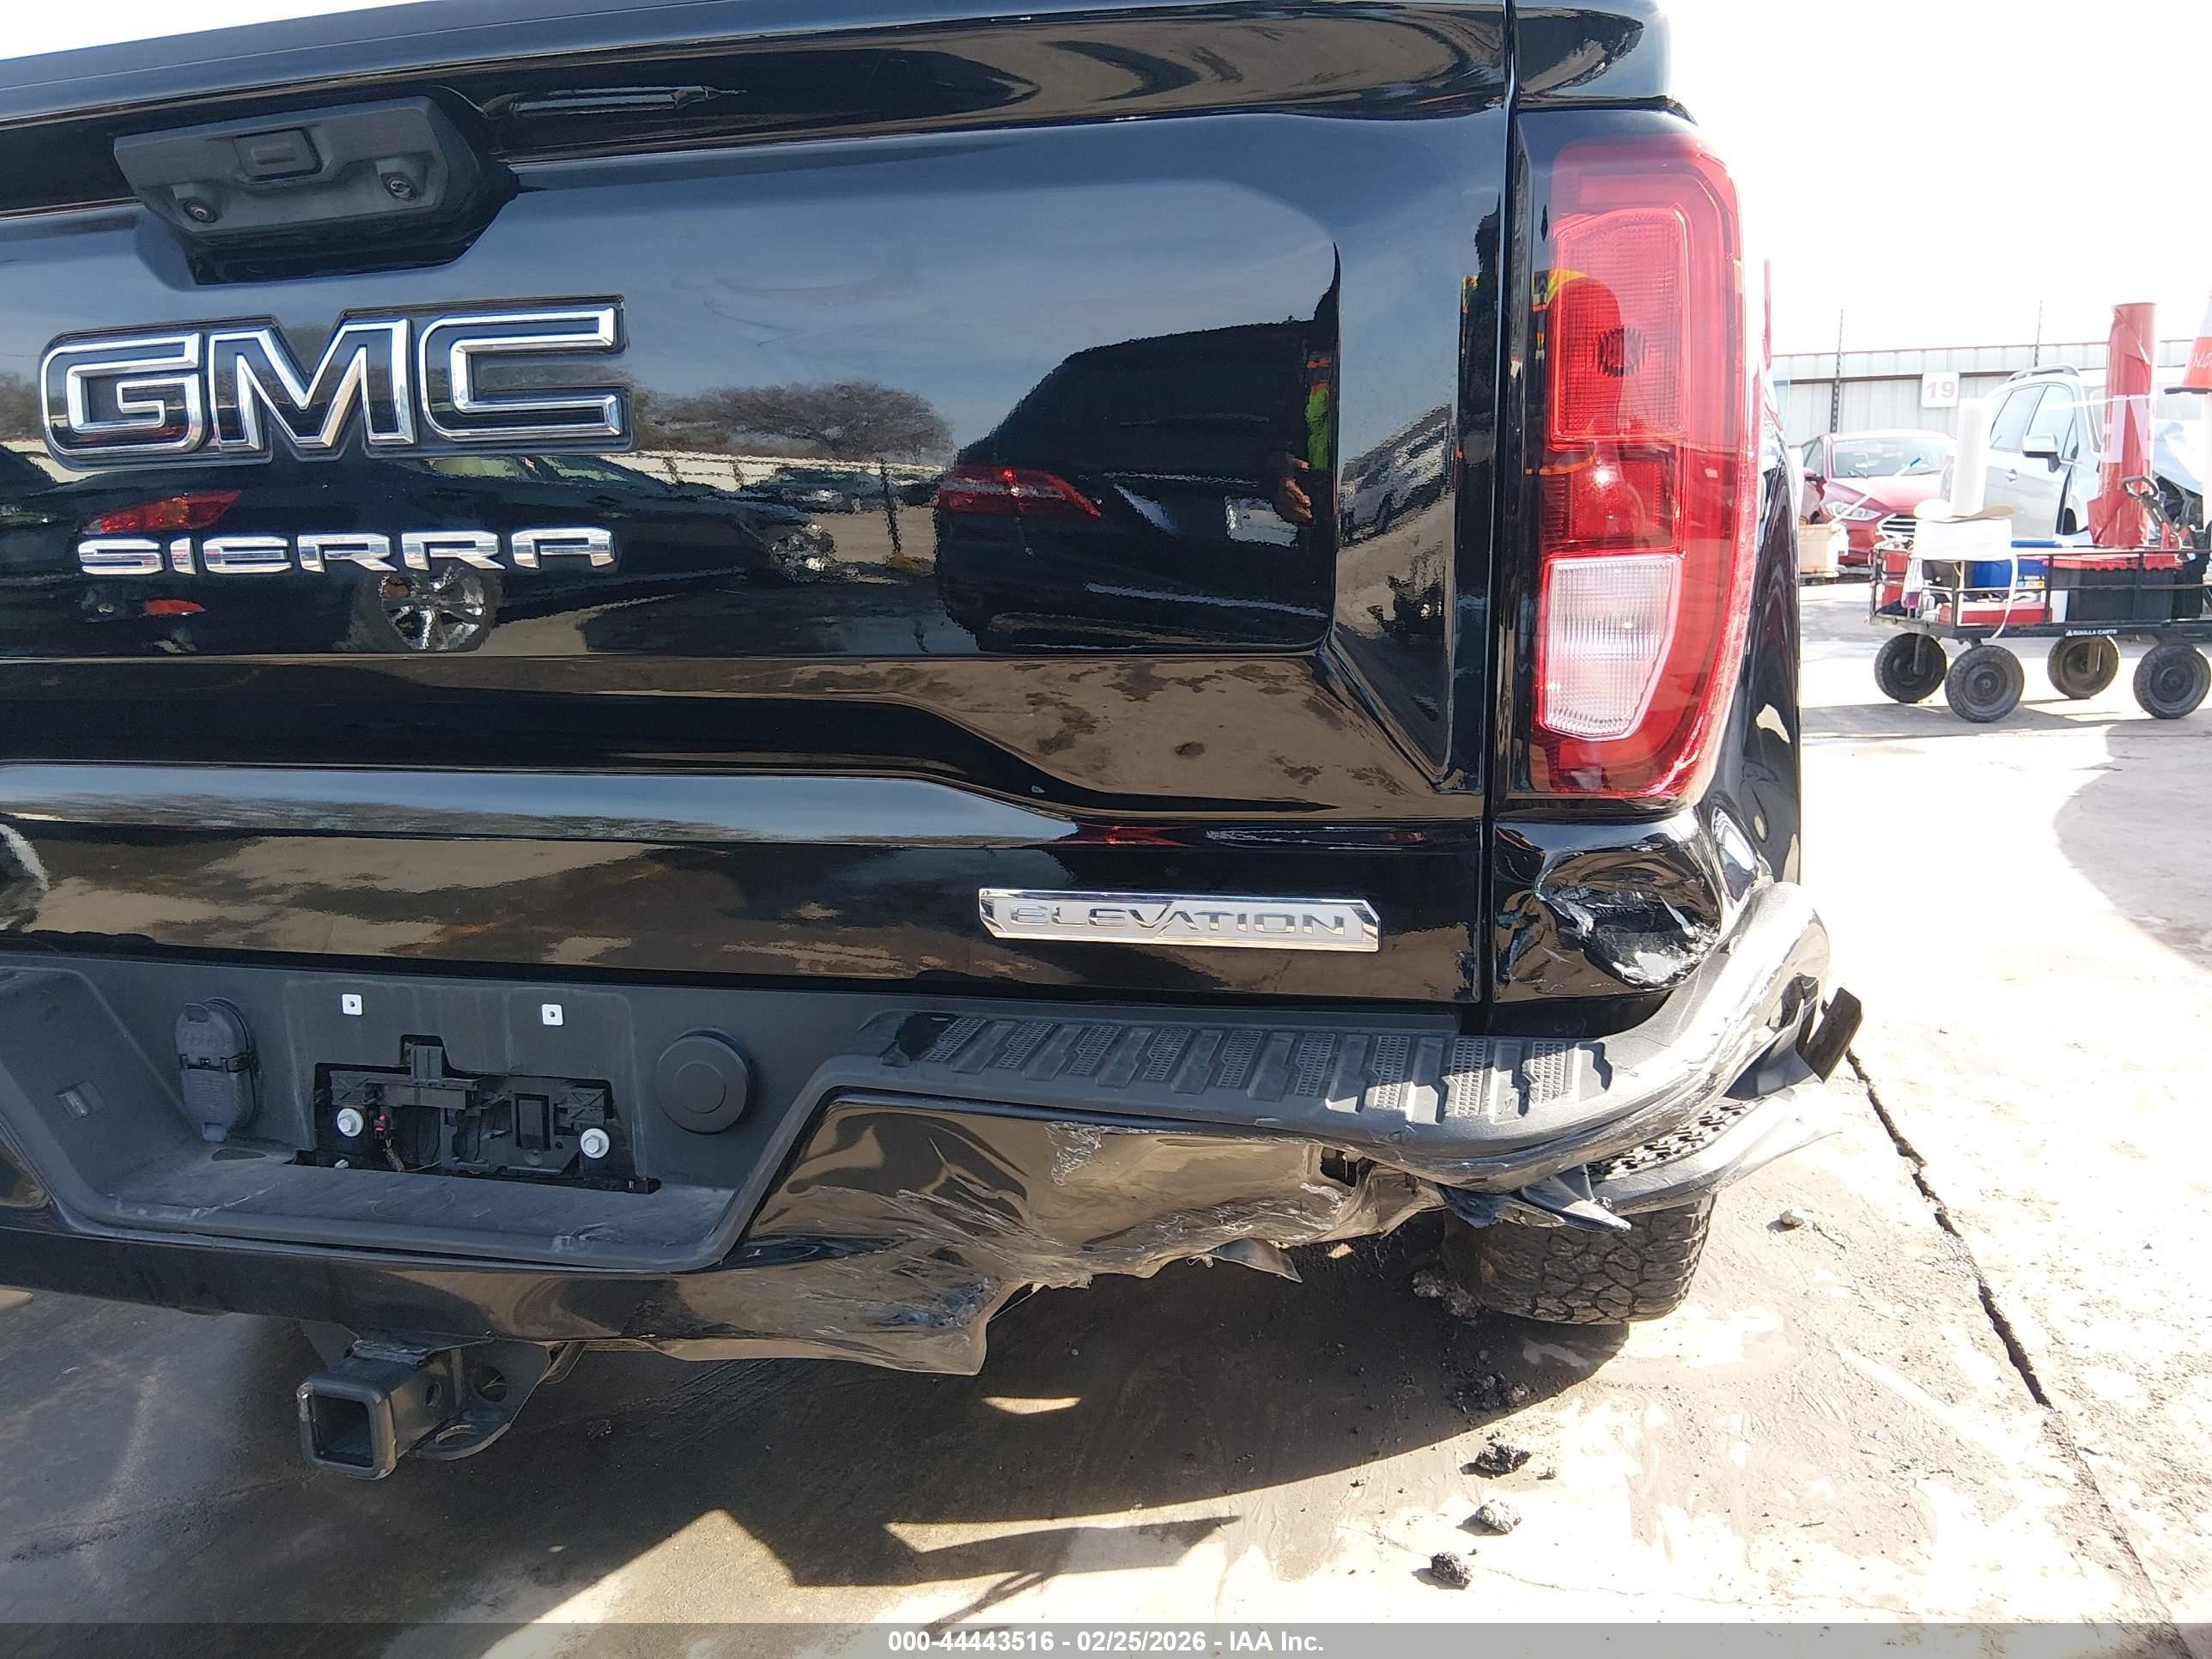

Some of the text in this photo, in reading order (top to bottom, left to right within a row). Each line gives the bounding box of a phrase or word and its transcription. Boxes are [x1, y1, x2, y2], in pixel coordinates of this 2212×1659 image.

[40, 306, 622, 455] GMC
[1925, 381, 1956, 398] 19
[77, 527, 616, 576] SIERRA
[1009, 902, 1346, 936] ELEVATION
